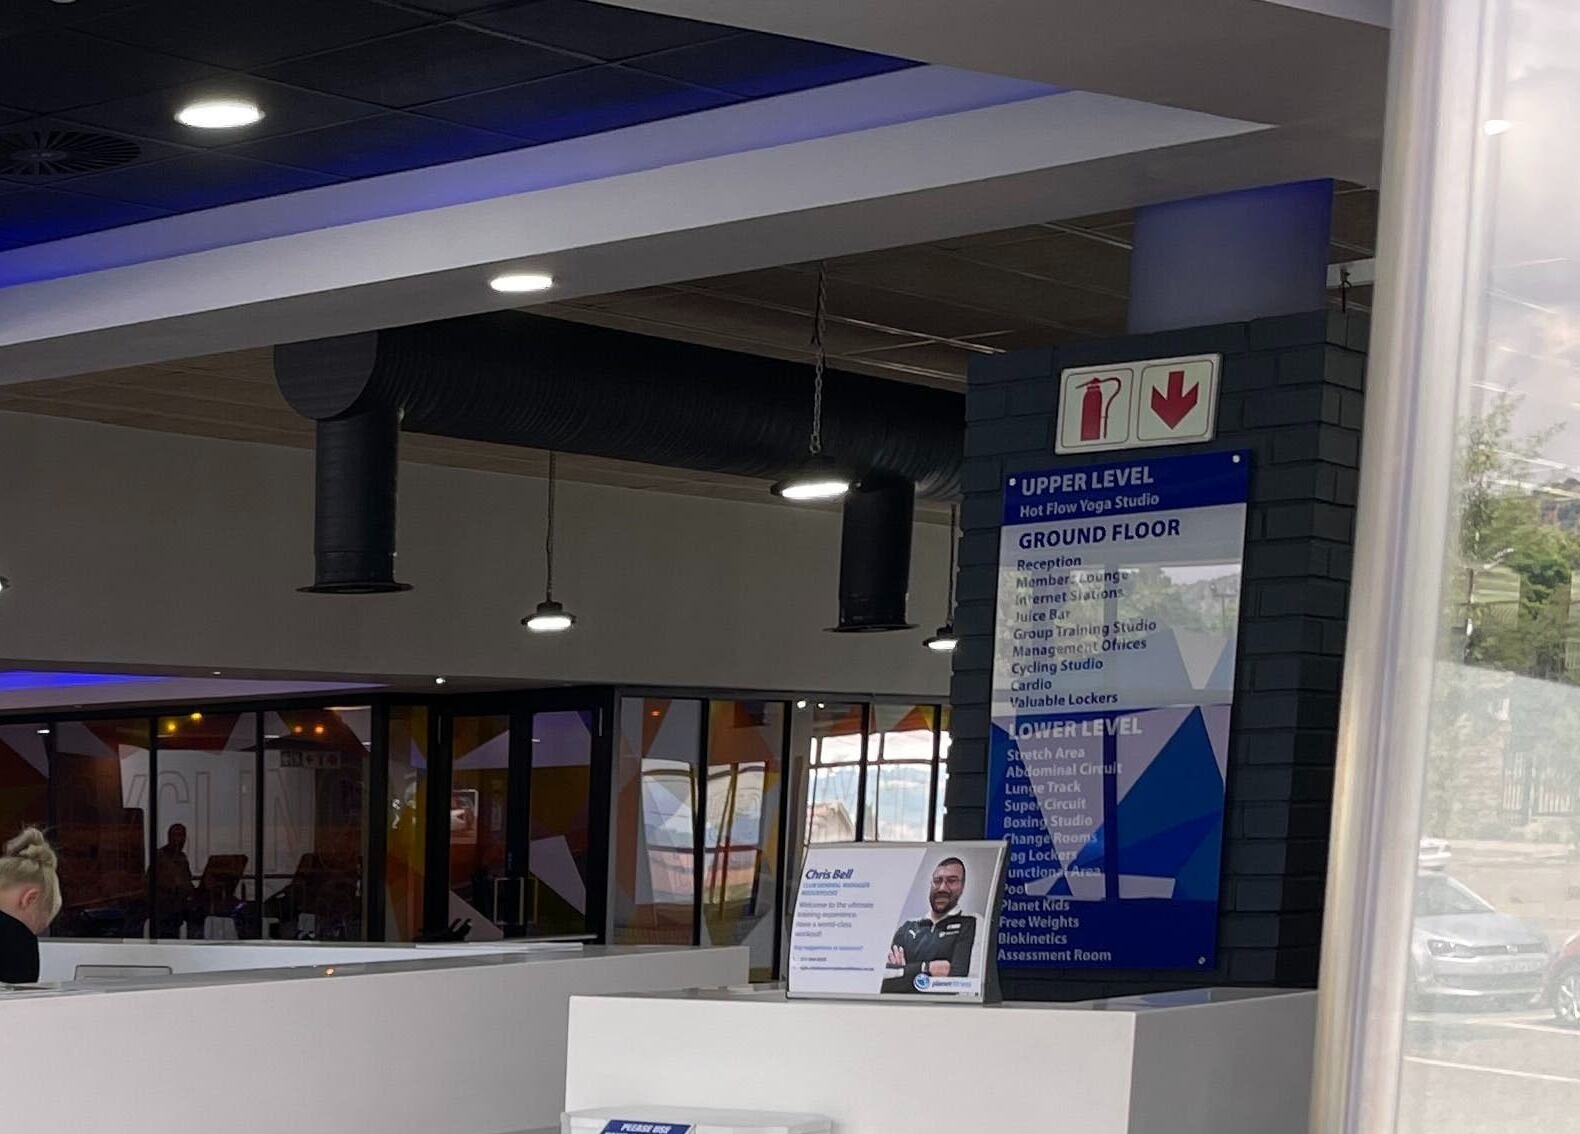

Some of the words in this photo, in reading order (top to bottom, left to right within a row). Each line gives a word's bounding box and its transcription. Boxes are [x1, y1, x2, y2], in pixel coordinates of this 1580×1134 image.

[1022, 472, 1086, 496] UPPER
[1092, 466, 1154, 490] LEVEL
[1020, 504, 1043, 518] Hot
[1046, 501, 1077, 516] Flow
[1080, 499, 1112, 515] Yoga
[1115, 493, 1160, 509] Studio
[1019, 526, 1106, 550] GROUND
[1112, 519, 1181, 542] FLOOR
[1017, 555, 1082, 572] Reception
[1015, 591, 1066, 606] Internet
[1070, 588, 1124, 601] Stations
[1016, 609, 1047, 623] Juice
[1049, 608, 1071, 620] Bar
[1013, 627, 1053, 641] Group
[1056, 623, 1110, 638] Training
[1113, 620, 1157, 635] Studio
[1012, 641, 1098, 658] Management
[1101, 637, 1147, 652] Offices
[1011, 660, 1057, 676] Cycling
[1060, 657, 1104, 671] Studio
[1010, 678, 1052, 692] Cardio
[1009, 694, 1065, 709] Valuable
[1068, 692, 1118, 706] Lockers
[1008, 720, 1077, 741] LOWER
[1082, 716, 1143, 737] LEVEL
[1007, 747, 1052, 762] Stretch
[1055, 746, 1086, 760] Area
[1006, 763, 1077, 779] Abdominal
[1080, 761, 1123, 776] Circuit
[1005, 782, 1045, 798] Lunge
[1047, 780, 1081, 793] Track
[1004, 799, 1042, 814] Super
[1044, 798, 1087, 811] Circuit
[1003, 816, 1046, 830] Boxing
[1050, 815, 1093, 828] Studio
[1002, 832, 1050, 848] Change
[1053, 831, 1098, 844] Rooms
[1010, 851, 1026, 864] ag
[1028, 848, 1077, 862] Lockers
[805, 868, 831, 880] Chris
[832, 868, 854, 880] Bell
[1008, 866, 1068, 878] unctional
[1071, 865, 1101, 877] Area
[1000, 899, 1040, 912] Planet
[1043, 899, 1070, 912] Kids
[999, 915, 1026, 928] Free
[1028, 915, 1079, 930] Weights
[998, 932, 1068, 945] Biokinetics
[997, 948, 1072, 962] Assessment
[1074, 948, 1112, 961] Room
